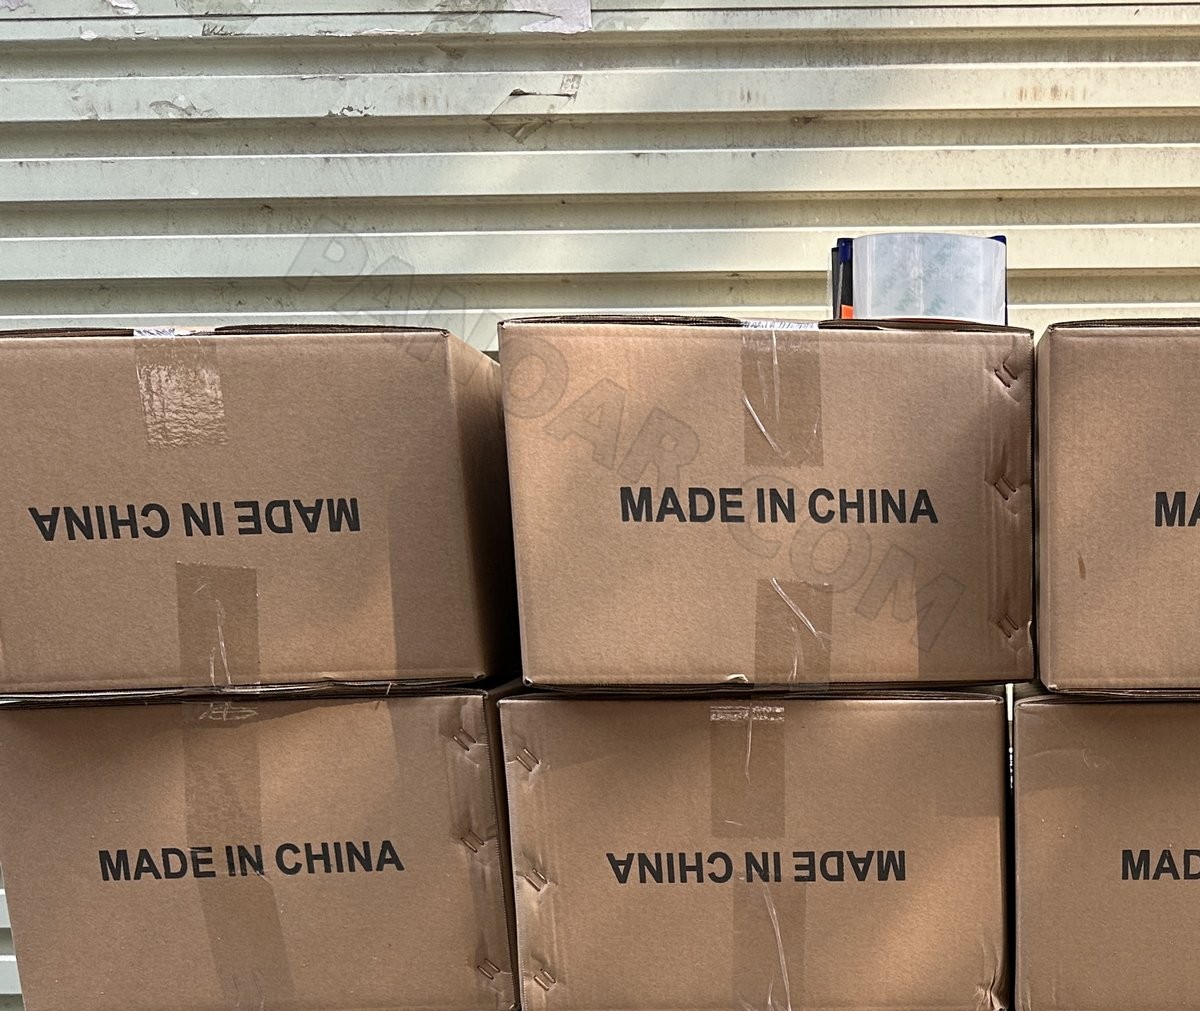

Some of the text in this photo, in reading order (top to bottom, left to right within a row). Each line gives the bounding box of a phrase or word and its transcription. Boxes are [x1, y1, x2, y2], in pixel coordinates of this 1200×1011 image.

[28, 498, 360, 541] MADE IN CHINA
[620, 487, 938, 523] MADE IN CHINA
[99, 840, 404, 881] MADE IN CHINA
[606, 850, 905, 883] MADE IN CHINA
